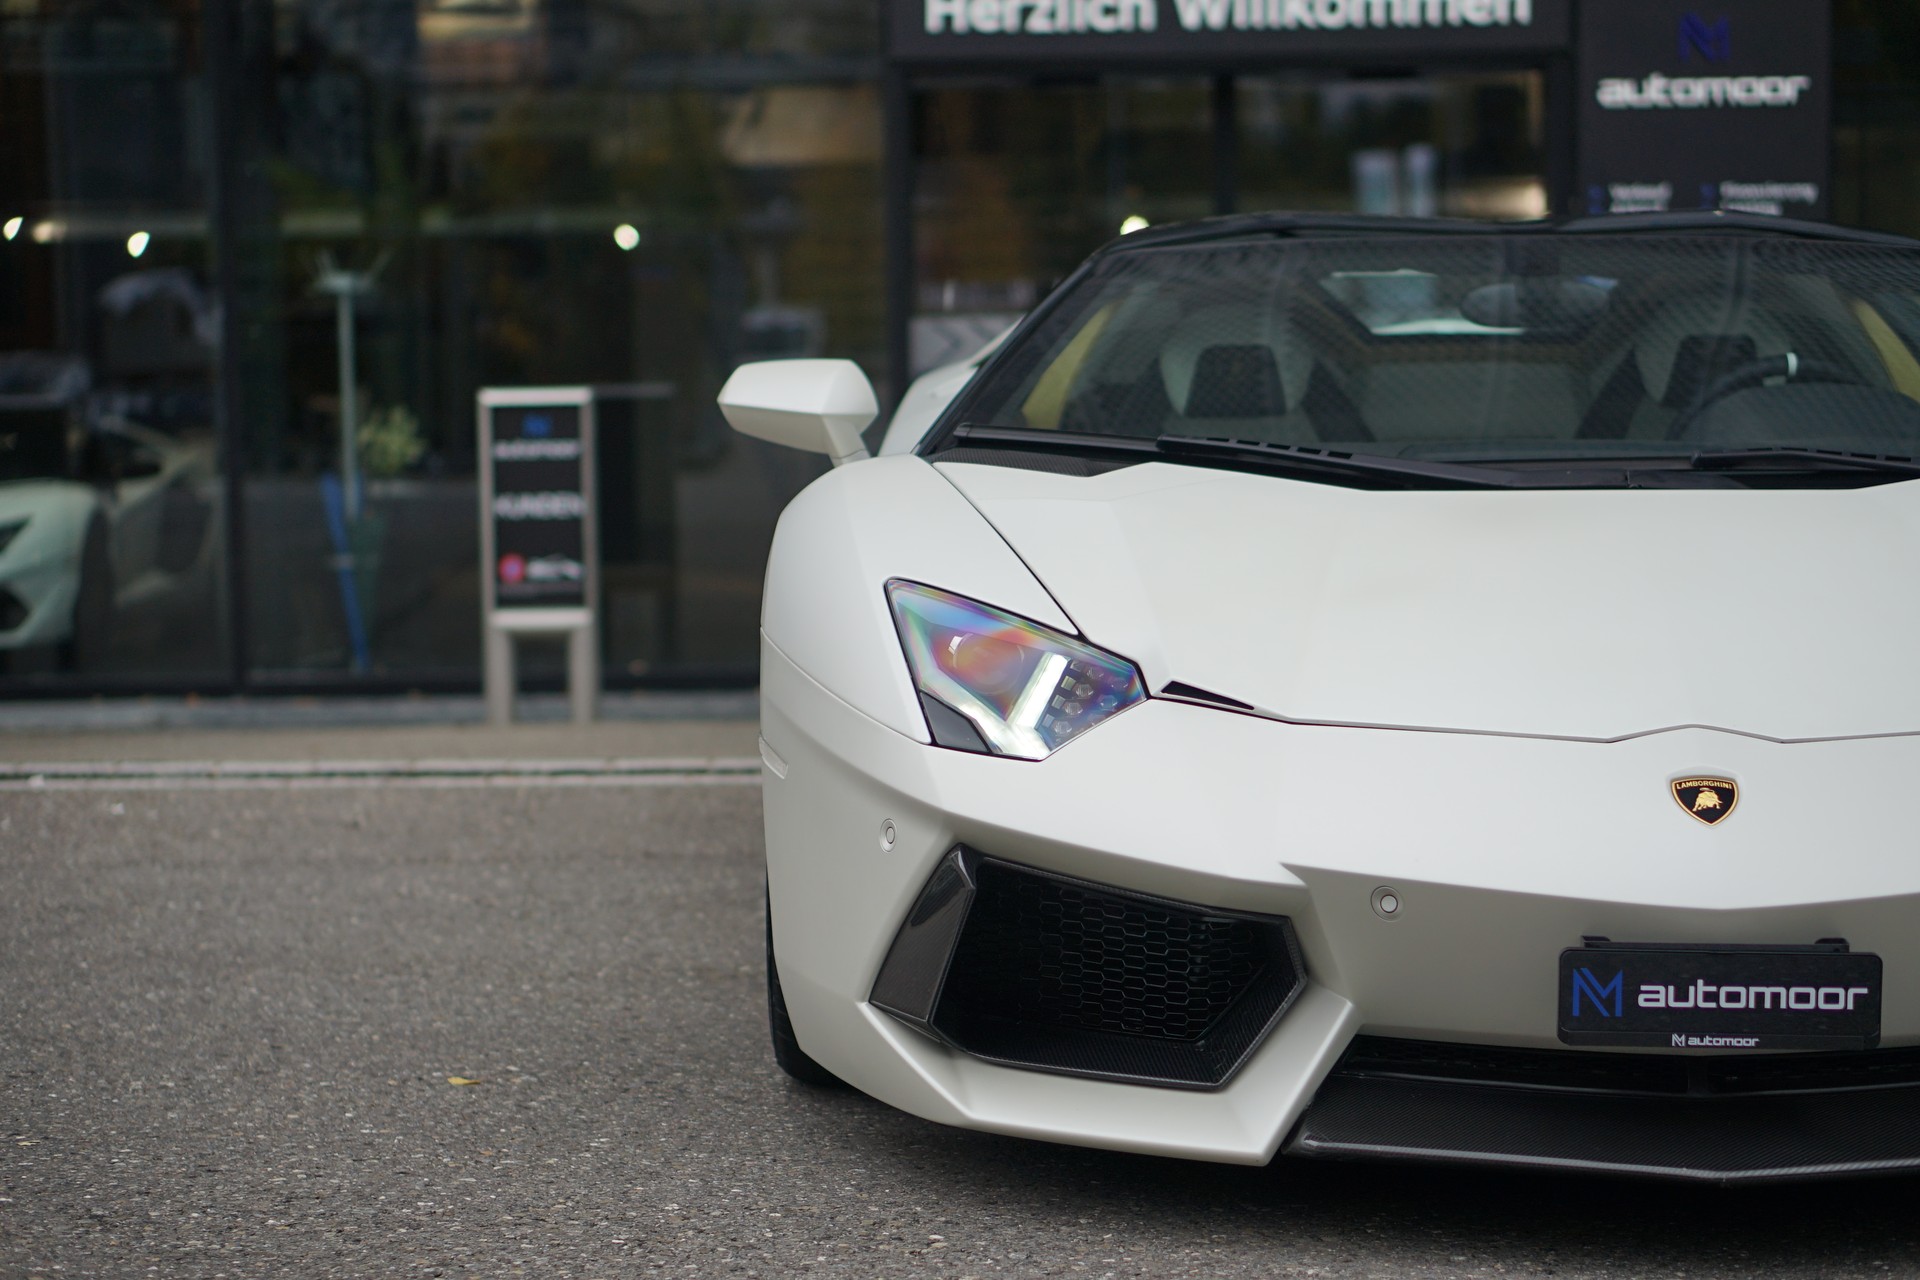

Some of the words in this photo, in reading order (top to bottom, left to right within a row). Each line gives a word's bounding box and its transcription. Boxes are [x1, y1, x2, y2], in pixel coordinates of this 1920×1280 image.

[925, 0, 1157, 33] Herzlich
[1174, 0, 1532, 30] Willkommen
[1597, 72, 1811, 108] automoor
[1676, 780, 1732, 790] LAMBORGHINI
[1637, 979, 1869, 1011] automoor
[1687, 1035, 1760, 1047] automoor
